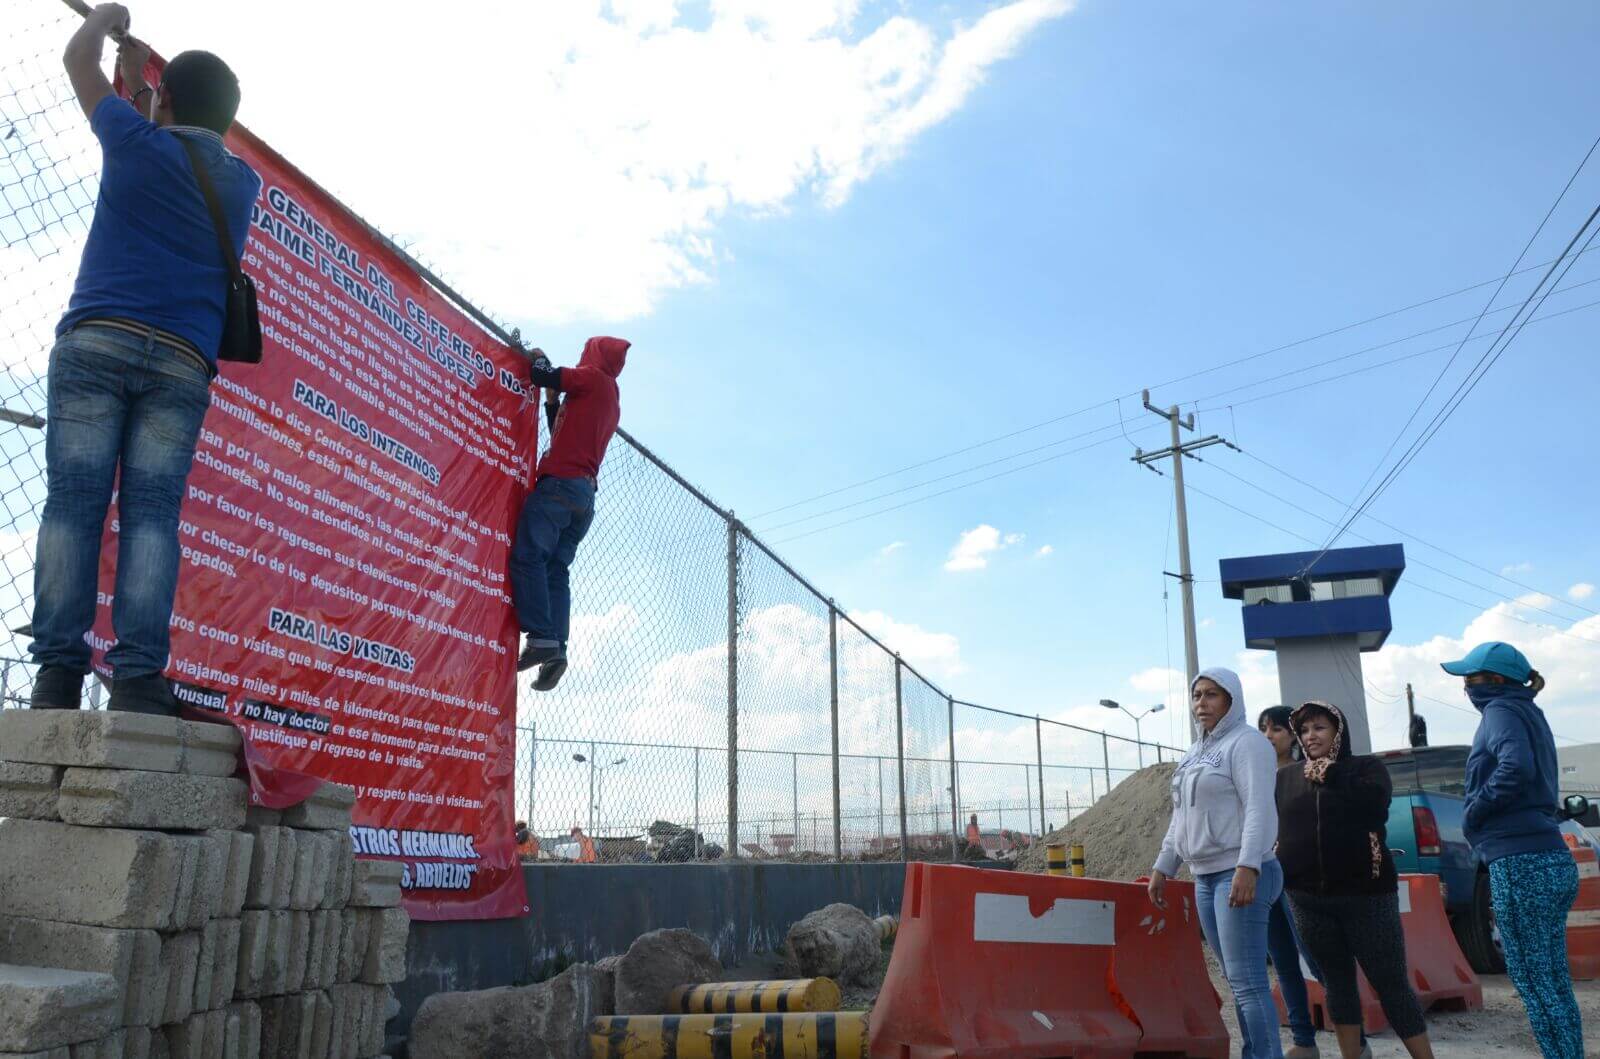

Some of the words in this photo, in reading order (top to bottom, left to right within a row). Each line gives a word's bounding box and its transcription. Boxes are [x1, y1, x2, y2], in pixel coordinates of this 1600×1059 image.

[266, 268, 340, 326] escuchados
[344, 322, 358, 338] ya
[361, 334, 381, 354] que
[383, 351, 396, 366] en
[414, 371, 443, 399] buzón
[268, 185, 364, 277] GENERAL
[367, 261, 399, 307] DEL
[406, 298, 495, 380] CE.FE.RE.SO
[500, 367, 528, 397] No.
[296, 271, 320, 293] que
[323, 290, 361, 323] somos
[364, 319, 403, 355] muchas
[405, 349, 442, 384] familias
[445, 378, 457, 392] de
[319, 252, 424, 352] FERNÁNDEZ
[426, 336, 477, 389] LÓPEZ
[269, 288, 288, 306] no
[291, 303, 305, 319] se
[308, 313, 327, 335] las
[329, 328, 366, 362] hagan
[368, 354, 398, 383] llegar
[400, 381, 413, 393] es
[433, 405, 449, 419] eso
[451, 415, 467, 432] que
[329, 367, 343, 383] su
[345, 378, 386, 411] amable
[388, 406, 433, 443] atención.
[339, 355, 352, 371] de
[355, 367, 380, 390] esta
[382, 383, 416, 415] forma,
[418, 408, 464, 447] esperando
[210, 391, 304, 458] humillaciones,
[307, 448, 341, 475] están
[344, 465, 391, 502] limitados
[394, 498, 407, 512] en
[270, 401, 283, 419] lo
[286, 411, 312, 436] dice
[315, 429, 352, 459] Centro
[354, 453, 368, 468] de
[369, 458, 436, 507] Readaptación
[293, 378, 339, 425] PARA
[339, 406, 369, 443] LOS
[371, 426, 441, 487] INTERNOS:
[188, 484, 213, 504] por
[216, 495, 253, 522] favor
[255, 511, 275, 532] les
[278, 525, 332, 559] regresen
[335, 551, 355, 568] sus
[357, 559, 417, 593] televisores
[193, 450, 263, 492] chonetas.
[267, 482, 283, 502] No
[287, 498, 309, 515] son
[311, 509, 370, 543] atendidos
[385, 542, 404, 559] con
[226, 441, 251, 461] por
[253, 452, 271, 474] los
[273, 467, 311, 495] malos
[314, 487, 375, 527] alimentos,
[377, 516, 392, 534] las
[181, 545, 237, 578] egados.
[202, 530, 251, 559] checar
[252, 548, 267, 566] lo
[269, 557, 286, 574] de
[288, 563, 307, 582] los
[311, 574, 369, 605] depósitos
[83, 630, 119, 652] Muc
[175, 658, 239, 687] viajamos
[242, 678, 277, 696] miles
[280, 687, 288, 701] y
[290, 689, 321, 708] miles
[324, 698, 339, 711] de
[343, 699, 400, 724] kilómetros
[402, 716, 423, 731] para
[424, 721, 441, 734] que
[199, 625, 239, 645] como
[243, 634, 286, 659] visitas
[288, 650, 312, 669] que
[314, 658, 333, 673] nos
[387, 679, 430, 699] nuestros
[269, 607, 315, 644] PARA
[318, 624, 351, 655] LAS
[353, 637, 416, 674] VISITAS:
[173, 683, 229, 714] Inusual,
[233, 701, 244, 715] y
[244, 703, 261, 717] no
[263, 706, 287, 726] hay
[289, 712, 330, 733] doctor
[348, 728, 369, 741] ese
[417, 741, 439, 755] para
[249, 724, 308, 749] justifique
[310, 738, 321, 751] el
[323, 742, 367, 759] regreso
[368, 750, 382, 762] de
[385, 751, 395, 764] la
[358, 786, 365, 798] y
[367, 786, 407, 801] respeto
[408, 789, 433, 804] hacia
[435, 793, 444, 805] el
